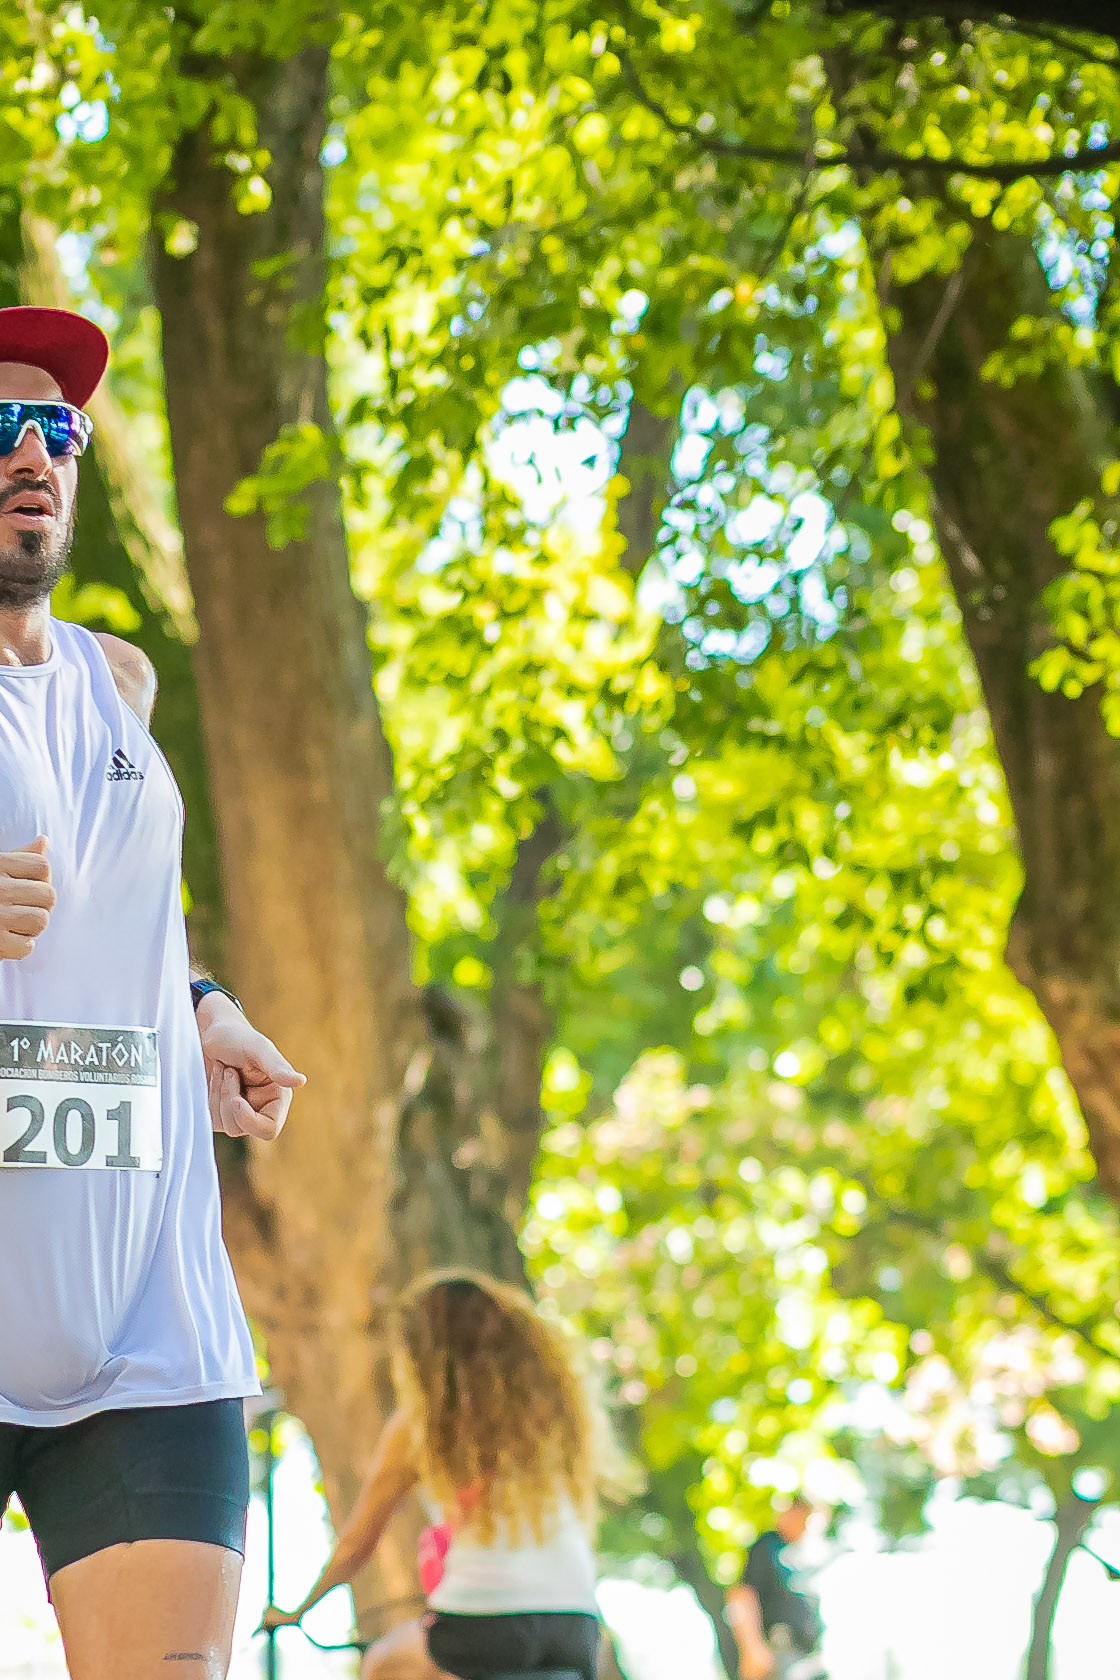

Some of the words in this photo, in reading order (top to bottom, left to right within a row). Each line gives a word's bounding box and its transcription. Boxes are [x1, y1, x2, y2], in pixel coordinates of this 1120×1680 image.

[106, 767, 144, 782] adidas
[36, 1036, 143, 1068] MARATÓN
[3, 1094, 140, 1168] 201
